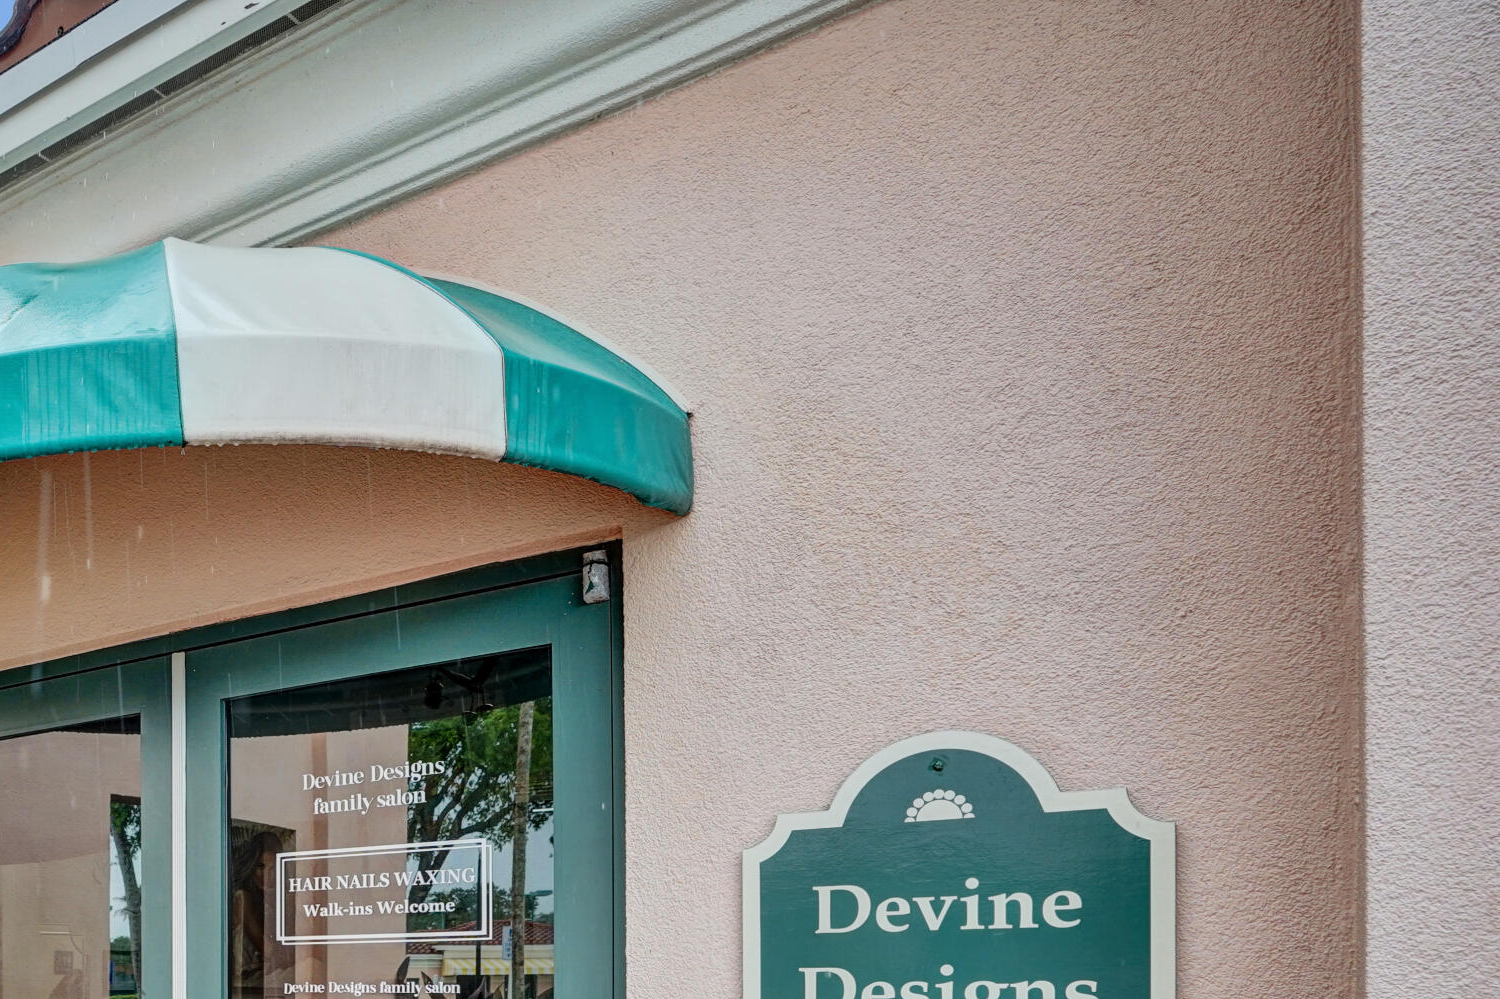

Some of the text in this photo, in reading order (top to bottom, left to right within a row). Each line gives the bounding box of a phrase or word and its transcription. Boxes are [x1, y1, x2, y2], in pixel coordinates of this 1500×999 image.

[302, 760, 446, 791] Devine Designs
[313, 788, 427, 815] family salon
[288, 867, 476, 892] HAIR NAILS WAXING
[303, 899, 456, 917] Walk-ins Welcome
[812, 877, 1083, 934] Devine
[283, 981, 461, 997] Devine Designs family salon
